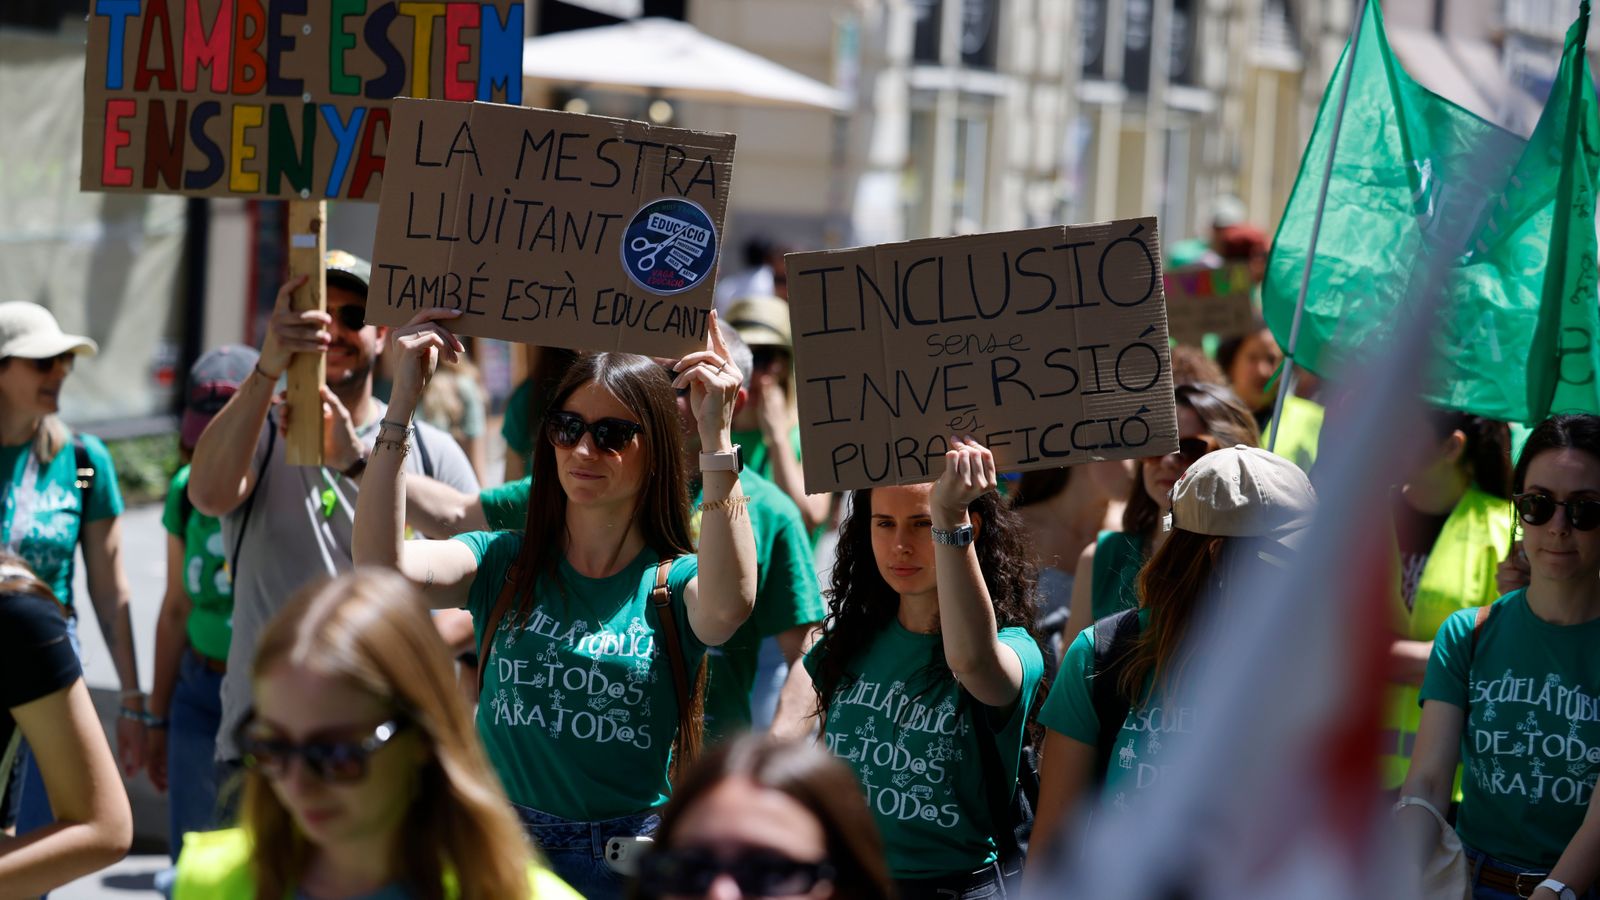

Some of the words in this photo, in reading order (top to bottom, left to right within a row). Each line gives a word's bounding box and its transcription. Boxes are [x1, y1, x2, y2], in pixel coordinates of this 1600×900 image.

[329, 0, 524, 105] ESTEM
[415, 120, 482, 176] LA
[515, 129, 717, 199] MESTRA
[650, 216, 706, 243] EDUCACIÓ
[378, 261, 490, 315] TAMBÉ
[501, 270, 579, 322] ESTÀ
[592, 287, 712, 342] EDUCANT
[799, 223, 1156, 338] INCLUSIÓ
[926, 333, 1030, 358] sense
[806, 325, 1161, 427] INVERSIÓ
[831, 434, 950, 484] PURA
[986, 405, 1150, 464] FICCIÓ
[946, 408, 984, 433] és
[499, 658, 535, 685] DE
[543, 663, 643, 705] TOD@S
[494, 700, 546, 728] PARA
[551, 707, 652, 749] TOD@S
[1475, 730, 1517, 755] DE
[859, 735, 946, 784] TOD@S
[865, 785, 960, 828] TOD@S
